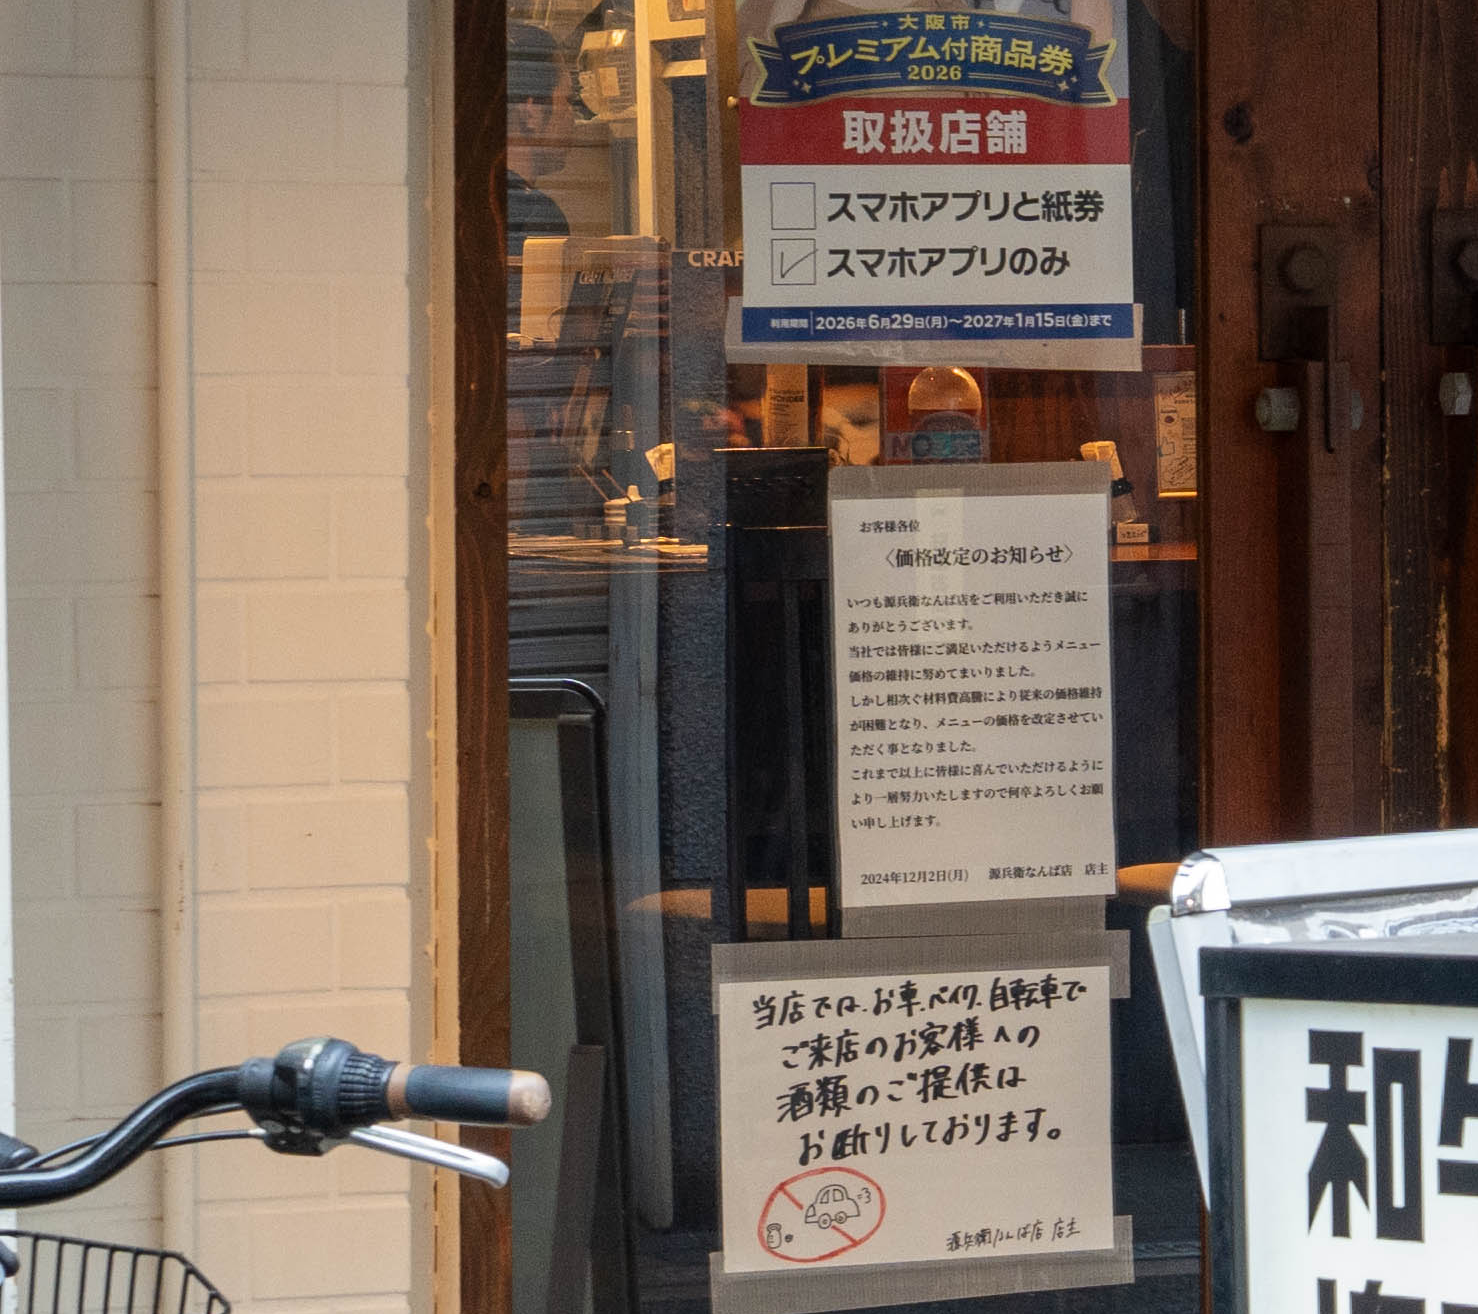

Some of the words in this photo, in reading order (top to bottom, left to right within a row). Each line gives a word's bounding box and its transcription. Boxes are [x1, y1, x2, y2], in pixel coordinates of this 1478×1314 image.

[898, 14, 971, 32] 大阪市
[791, 34, 1075, 77] プレミアム付商品券
[907, 65, 962, 81] 2026
[843, 109, 1028, 155] 取扱店舗
[827, 189, 1105, 223] スマホアプリと紙券
[827, 247, 1071, 278] スマホアプリのみ
[859, 520, 920, 533] お客様各位
[885, 544, 1073, 568] 〈価格改定のお知らせ〉
[847, 591, 1088, 609] いつも源兵衛なんば店をご利用いただき誠に
[848, 618, 974, 634] ありがとうございます。
[849, 640, 1101, 658] 当社では皆様にご満足いただけるようメニュー
[849, 665, 1036, 683] 価格の維持に努めてまいりました。
[851, 687, 1102, 707] しかし相次ぐ材料費高騰により従来の価格維持
[850, 712, 1103, 732] が困難となり、メニューの価格を改定させてい
[850, 740, 976, 756] ただく事となりました。
[851, 759, 1103, 781] これまで以上に皆様に喜んでいただけるように
[851, 783, 1103, 805] より一層努力いたしますので何卒よろしくお願
[851, 815, 941, 830] い申し上げます。
[861, 870, 968, 885] 2024年12月2日(月)
[989, 865, 1072, 880] 源兵衛なんば店
[1084, 863, 1109, 876] 店主
[782, 1016, 1041, 1070] ご来店のお客様への
[776, 1063, 1027, 1123] 酒類のご提供は
[799, 1108, 1062, 1165] お断りしております。
